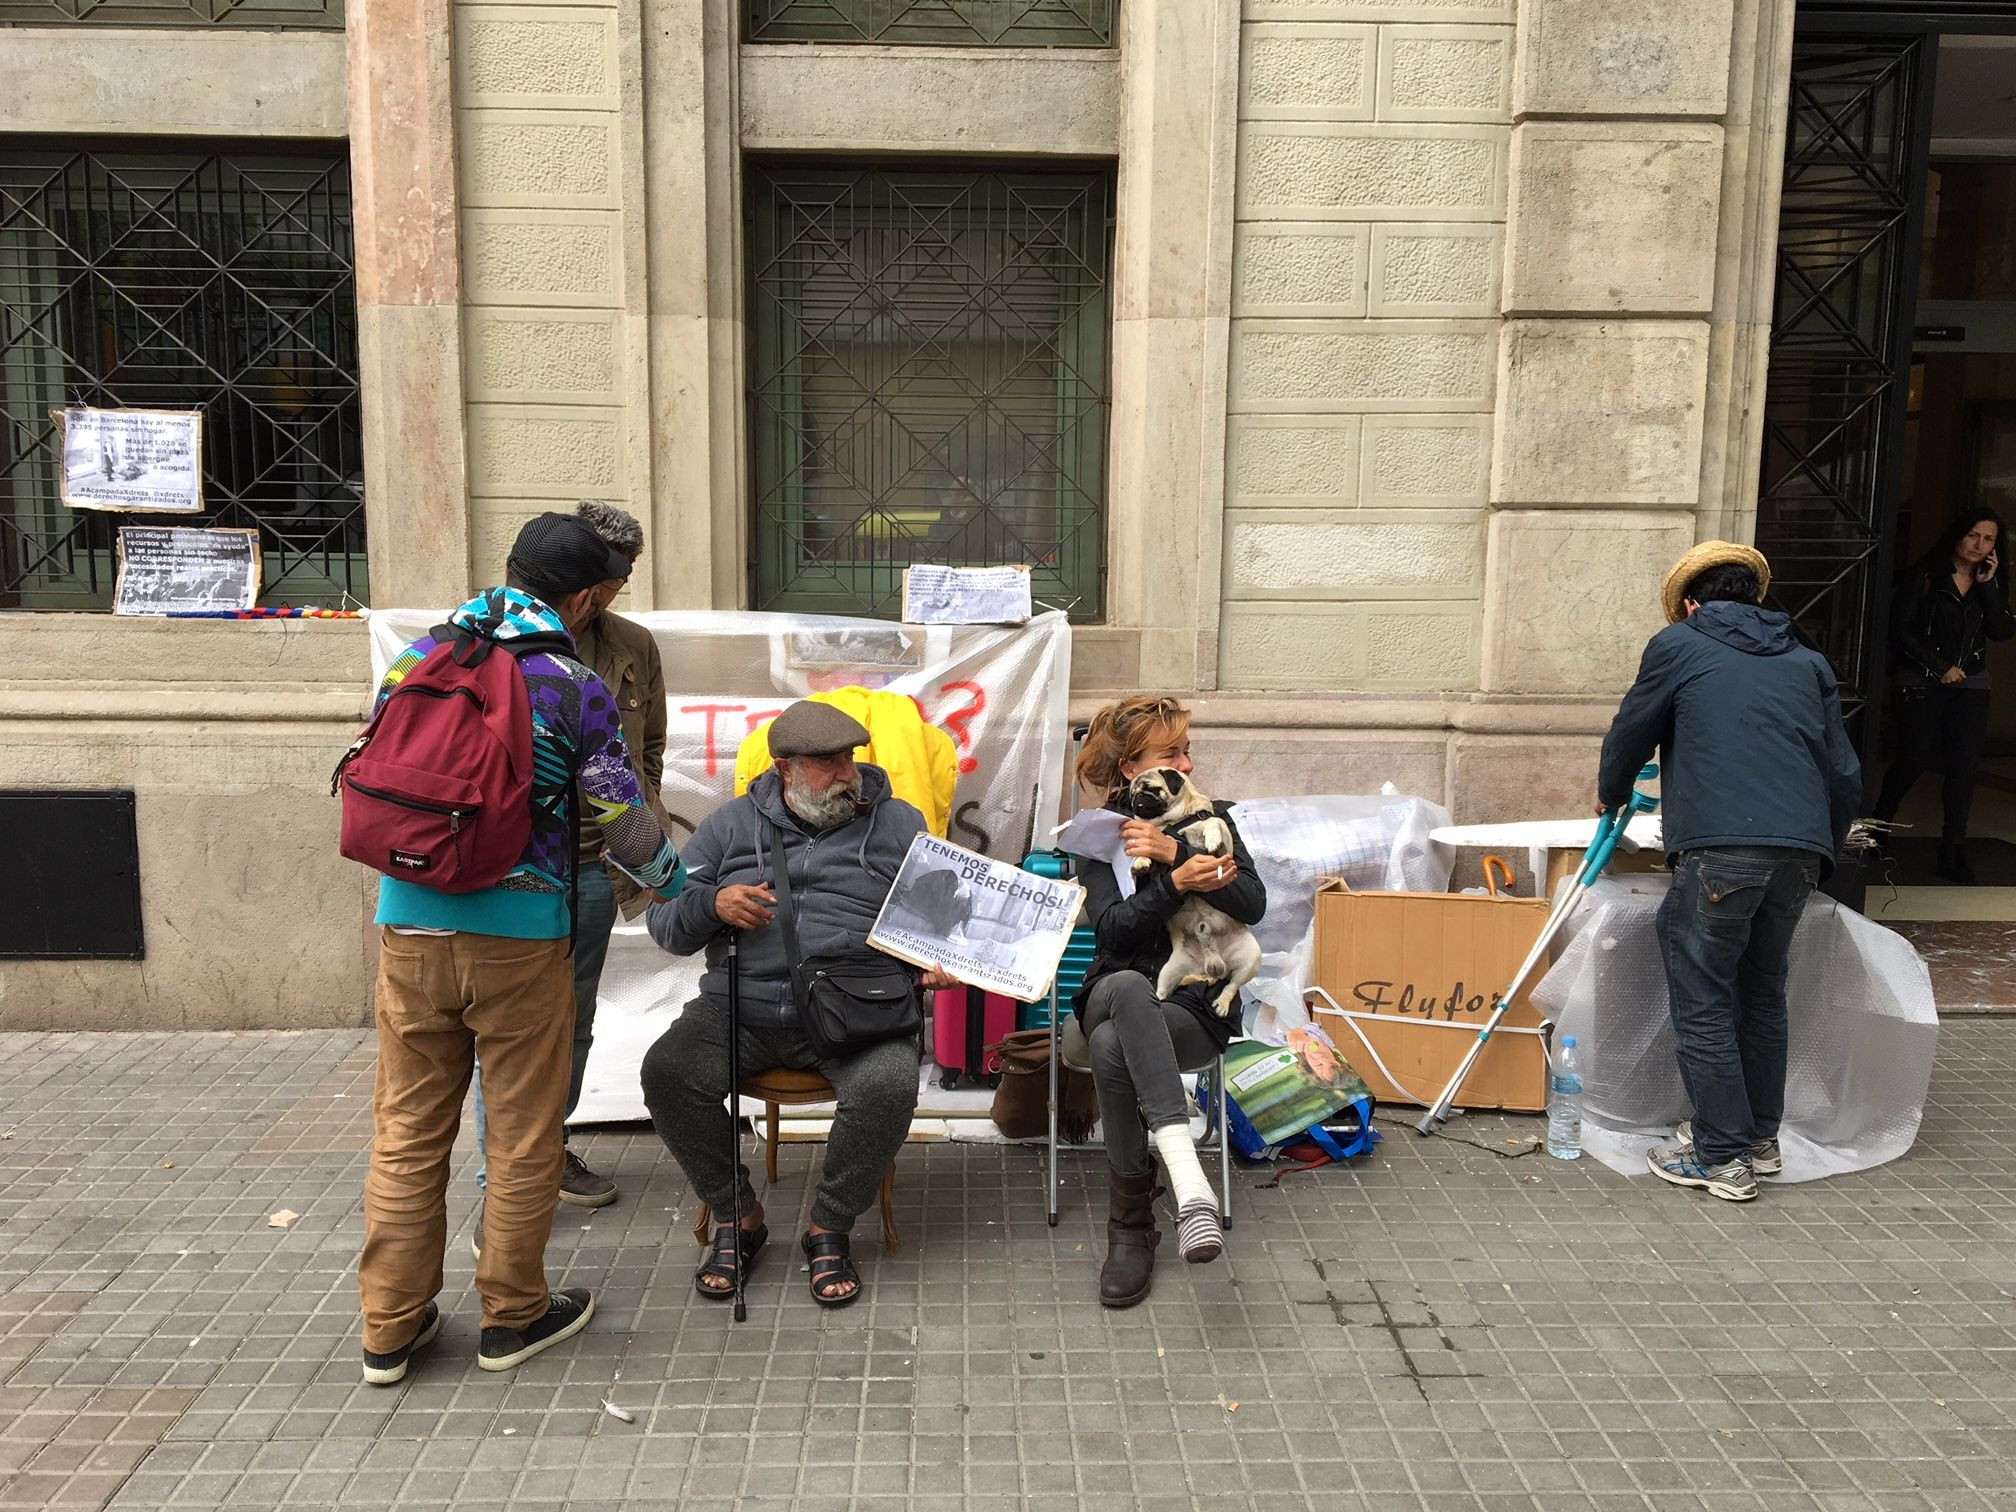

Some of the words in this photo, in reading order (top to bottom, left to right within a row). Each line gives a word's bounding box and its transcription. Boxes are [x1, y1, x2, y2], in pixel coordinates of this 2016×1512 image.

[100, 416, 138, 425] Barcelona
[141, 418, 153, 426] hay
[71, 493, 191, 505] www.derechosgarantizados.org
[135, 532, 168, 540] principal
[171, 533, 206, 541] problema
[141, 555, 205, 564] CORRESPONDEN
[128, 563, 173, 571] necesidades
[396, 856, 424, 867] EASTPAK
[924, 839, 989, 873] TENEMOS
[961, 867, 1063, 910] DERECHOS!
[895, 929, 983, 969] #AcampadaXdrets
[988, 964, 1027, 983] @xdrets
[880, 931, 1034, 993] www.derechosgarantizados.org
